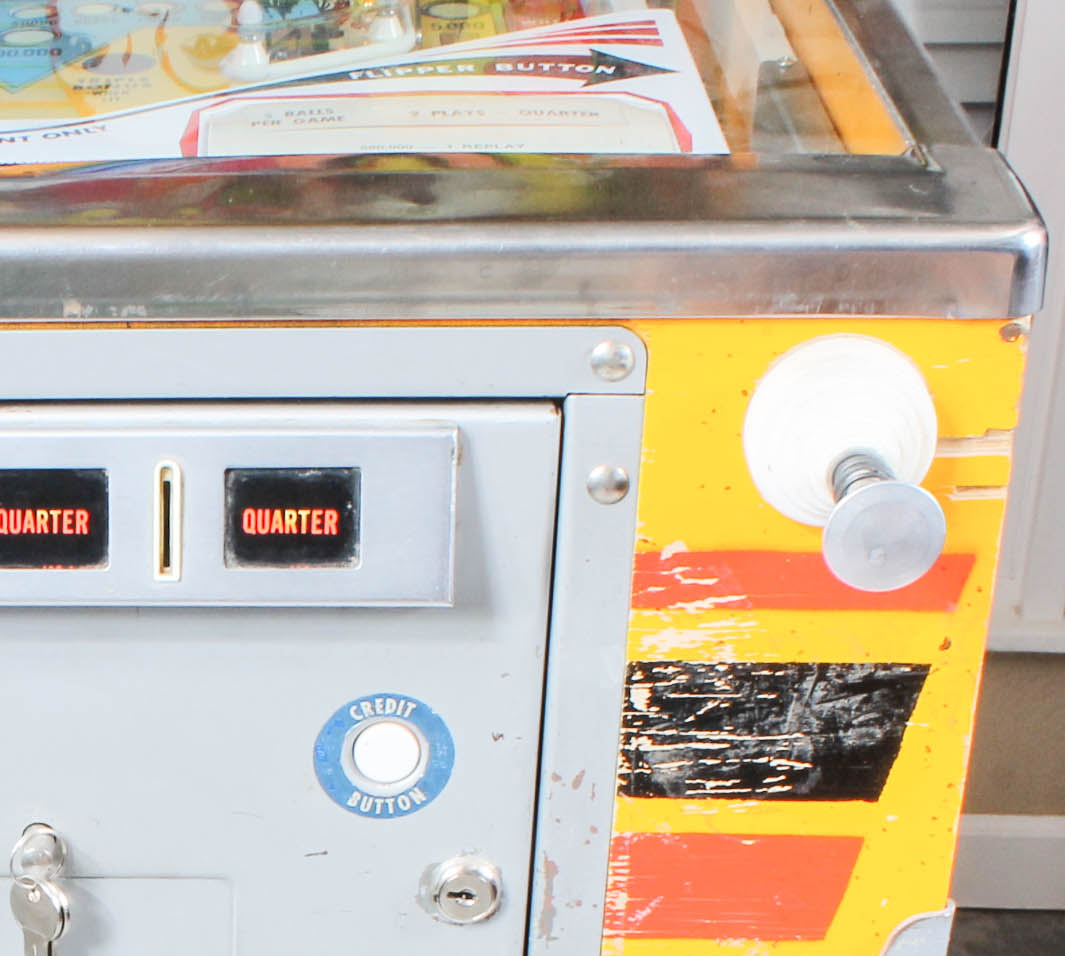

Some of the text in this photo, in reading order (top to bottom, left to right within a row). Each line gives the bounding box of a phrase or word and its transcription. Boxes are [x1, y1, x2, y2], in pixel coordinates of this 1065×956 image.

[347, 62, 618, 80] FLIPPER BUTTON
[251, 114, 345, 128] PER GAME
[284, 107, 336, 118] BALLS
[430, 109, 487, 118] PLAYS
[519, 109, 601, 118] QUARTER
[40, 123, 108, 141] ONLY
[242, 507, 340, 536] QUARTER
[348, 697, 418, 721] CREDIT
[346, 785, 428, 815] BUTTON
